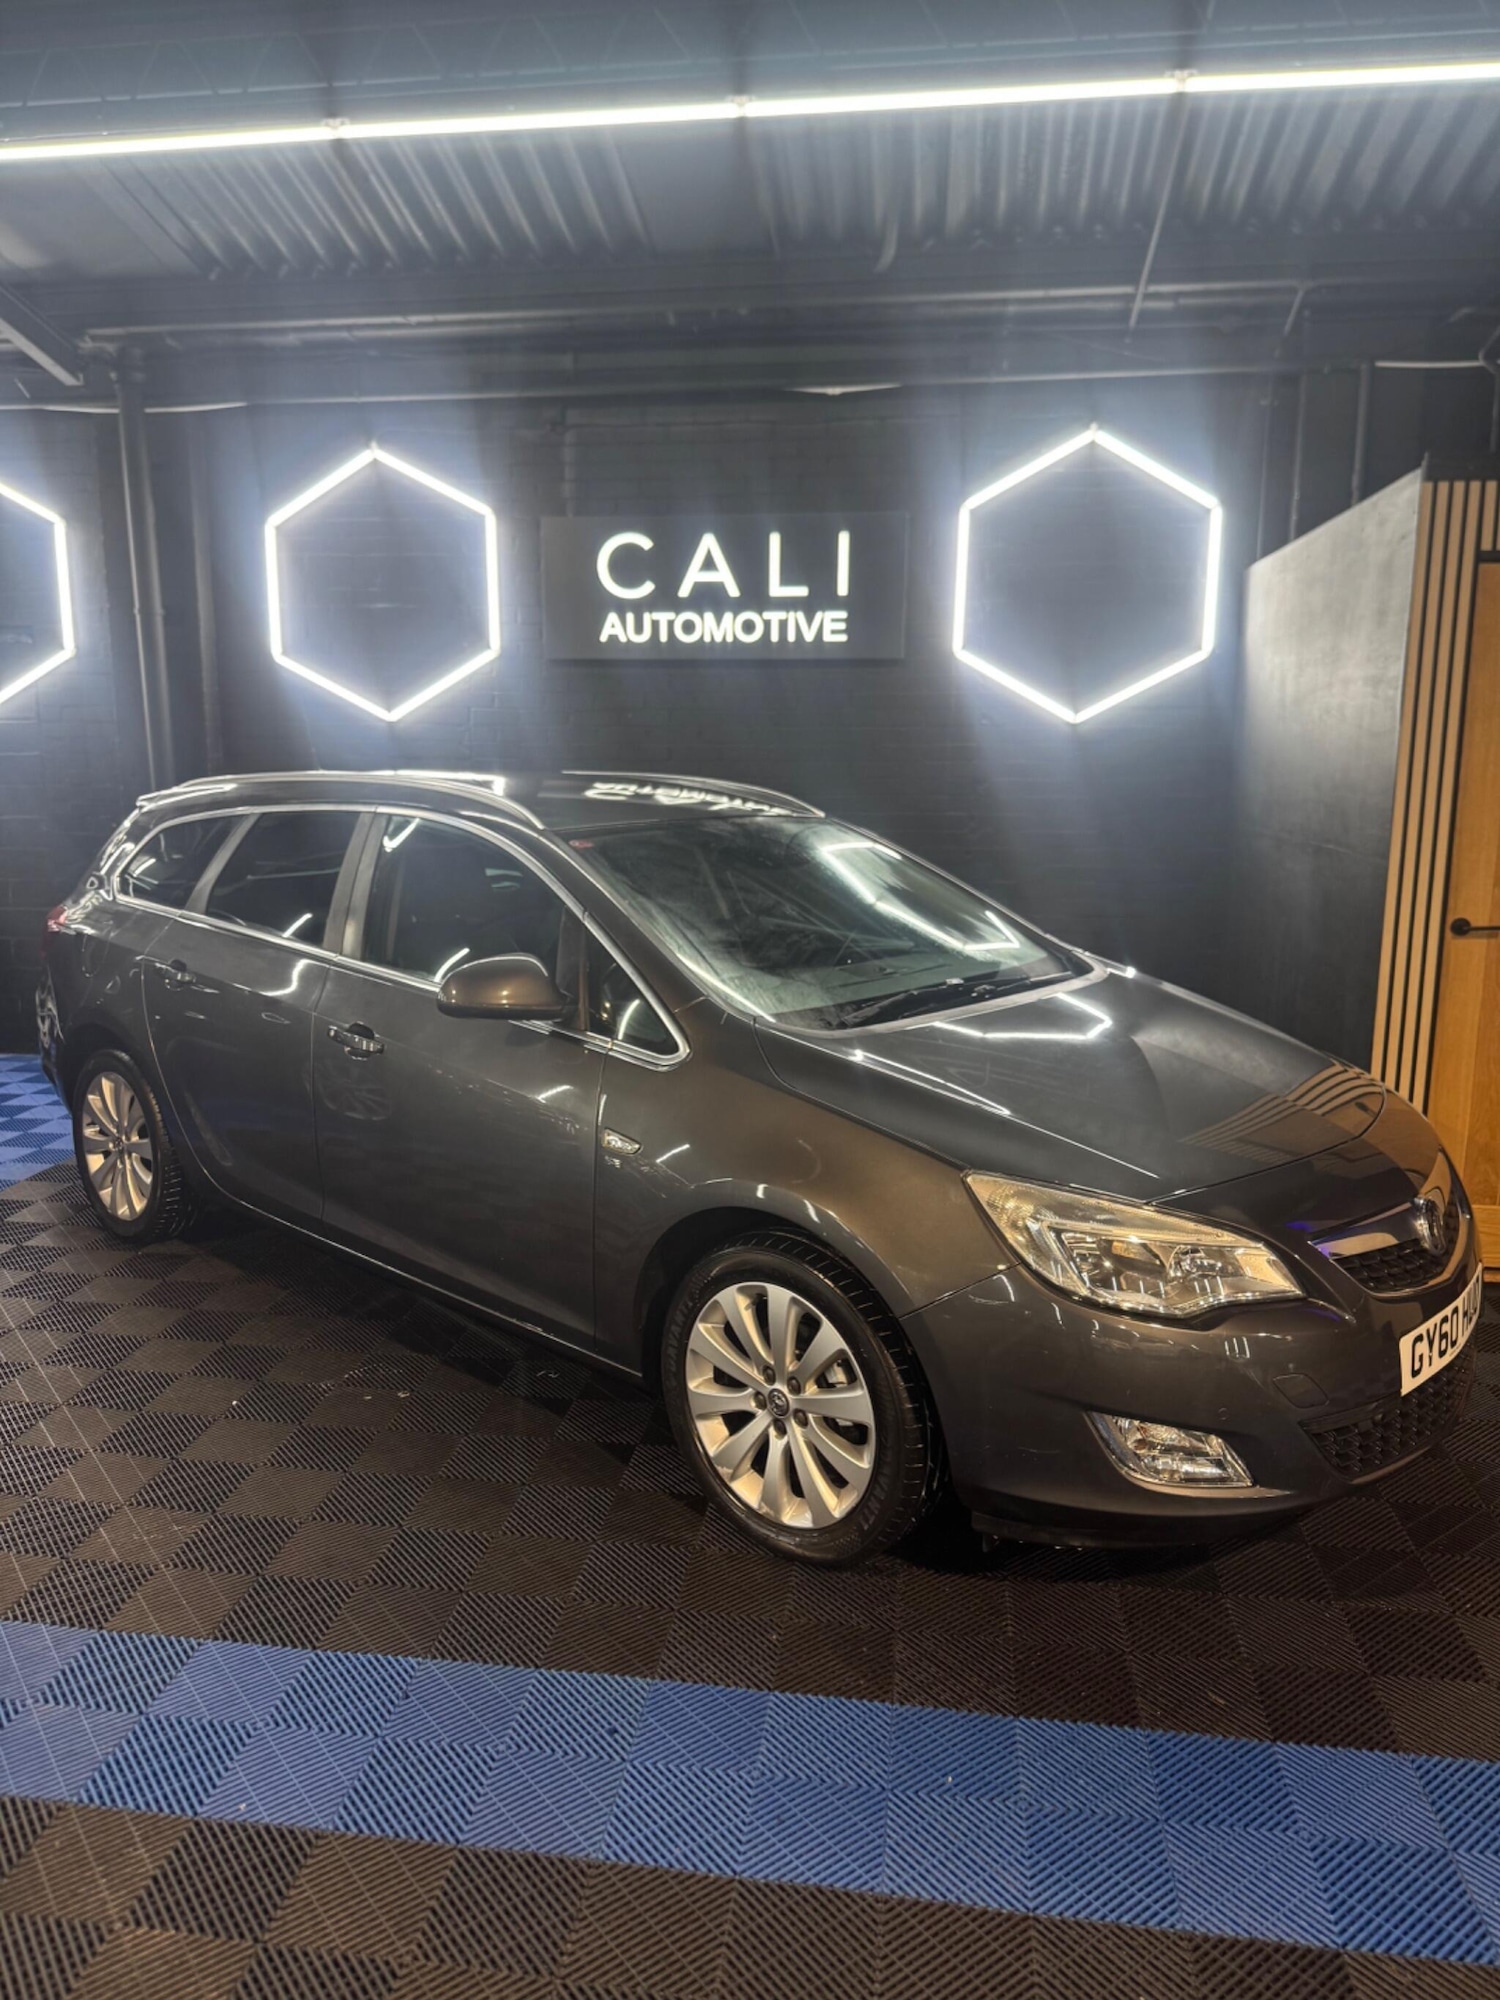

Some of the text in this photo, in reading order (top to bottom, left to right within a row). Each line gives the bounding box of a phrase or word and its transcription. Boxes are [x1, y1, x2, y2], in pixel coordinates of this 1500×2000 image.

[596, 530, 850, 599] CALI
[599, 610, 848, 643] AUTOMOTIVE
[1411, 1305, 1459, 1379] GY60
